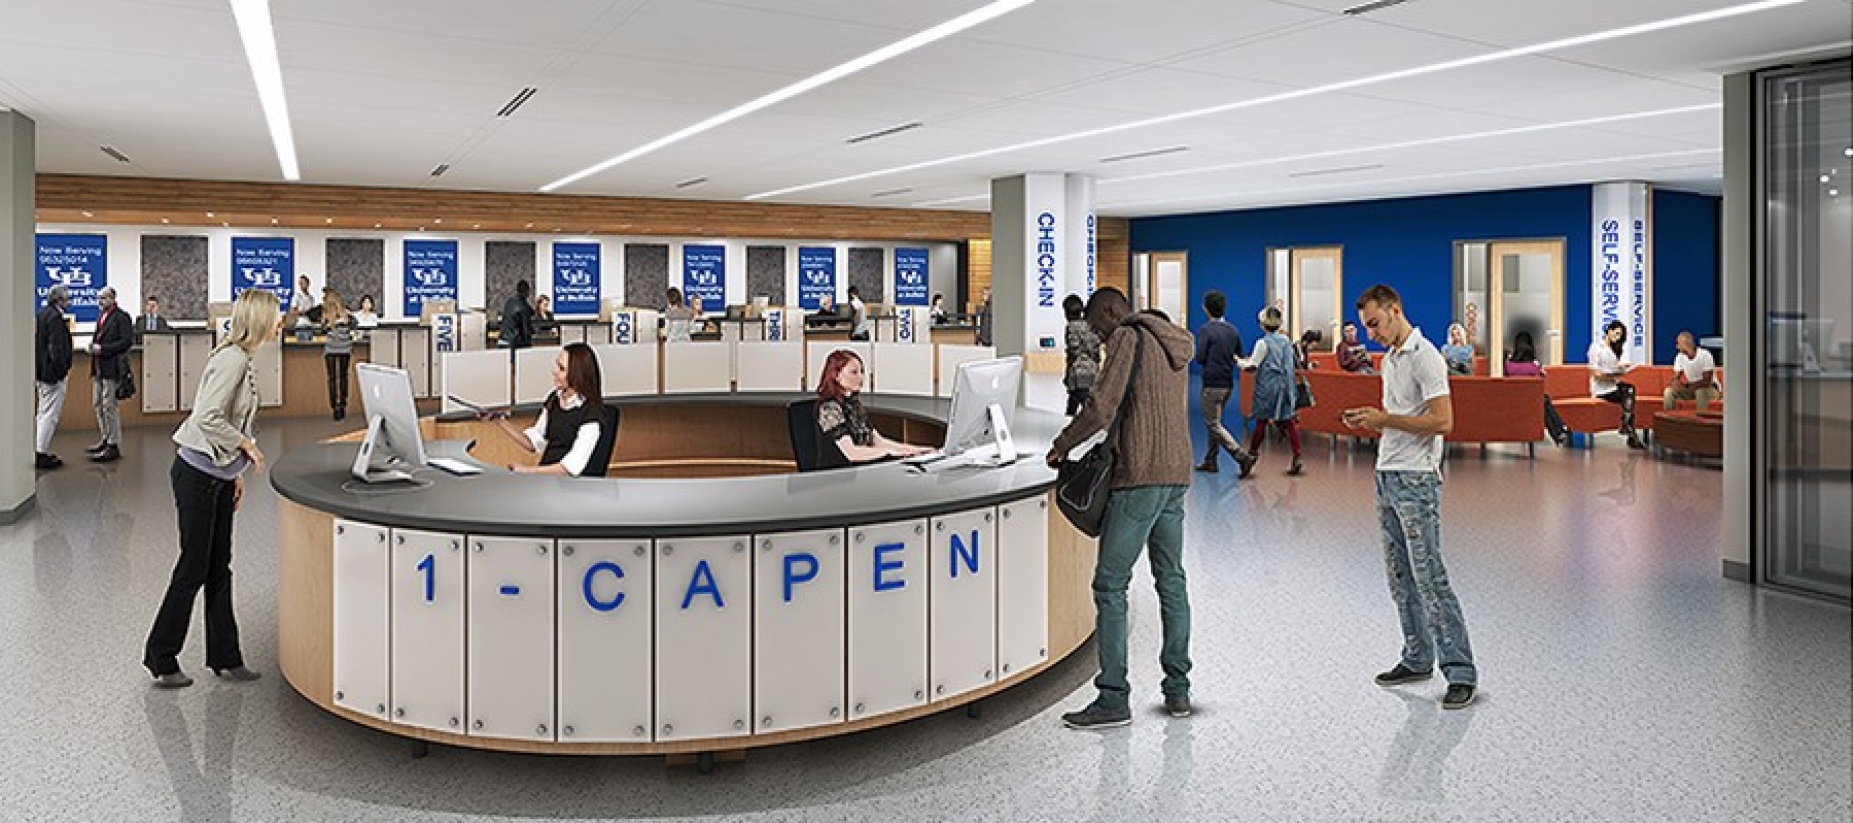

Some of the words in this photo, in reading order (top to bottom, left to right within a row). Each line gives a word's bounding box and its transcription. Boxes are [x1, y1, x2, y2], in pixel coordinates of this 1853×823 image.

[39, 246, 62, 254] Now
[65, 246, 102, 256] Serving
[1037, 212, 1055, 307] CHECK-IN
[1602, 220, 1619, 334] SELF-SERVI
[438, 315, 453, 352] FIVE
[617, 313, 630, 345] FOU
[769, 311, 781, 341] THR
[900, 309, 910, 339] TWO
